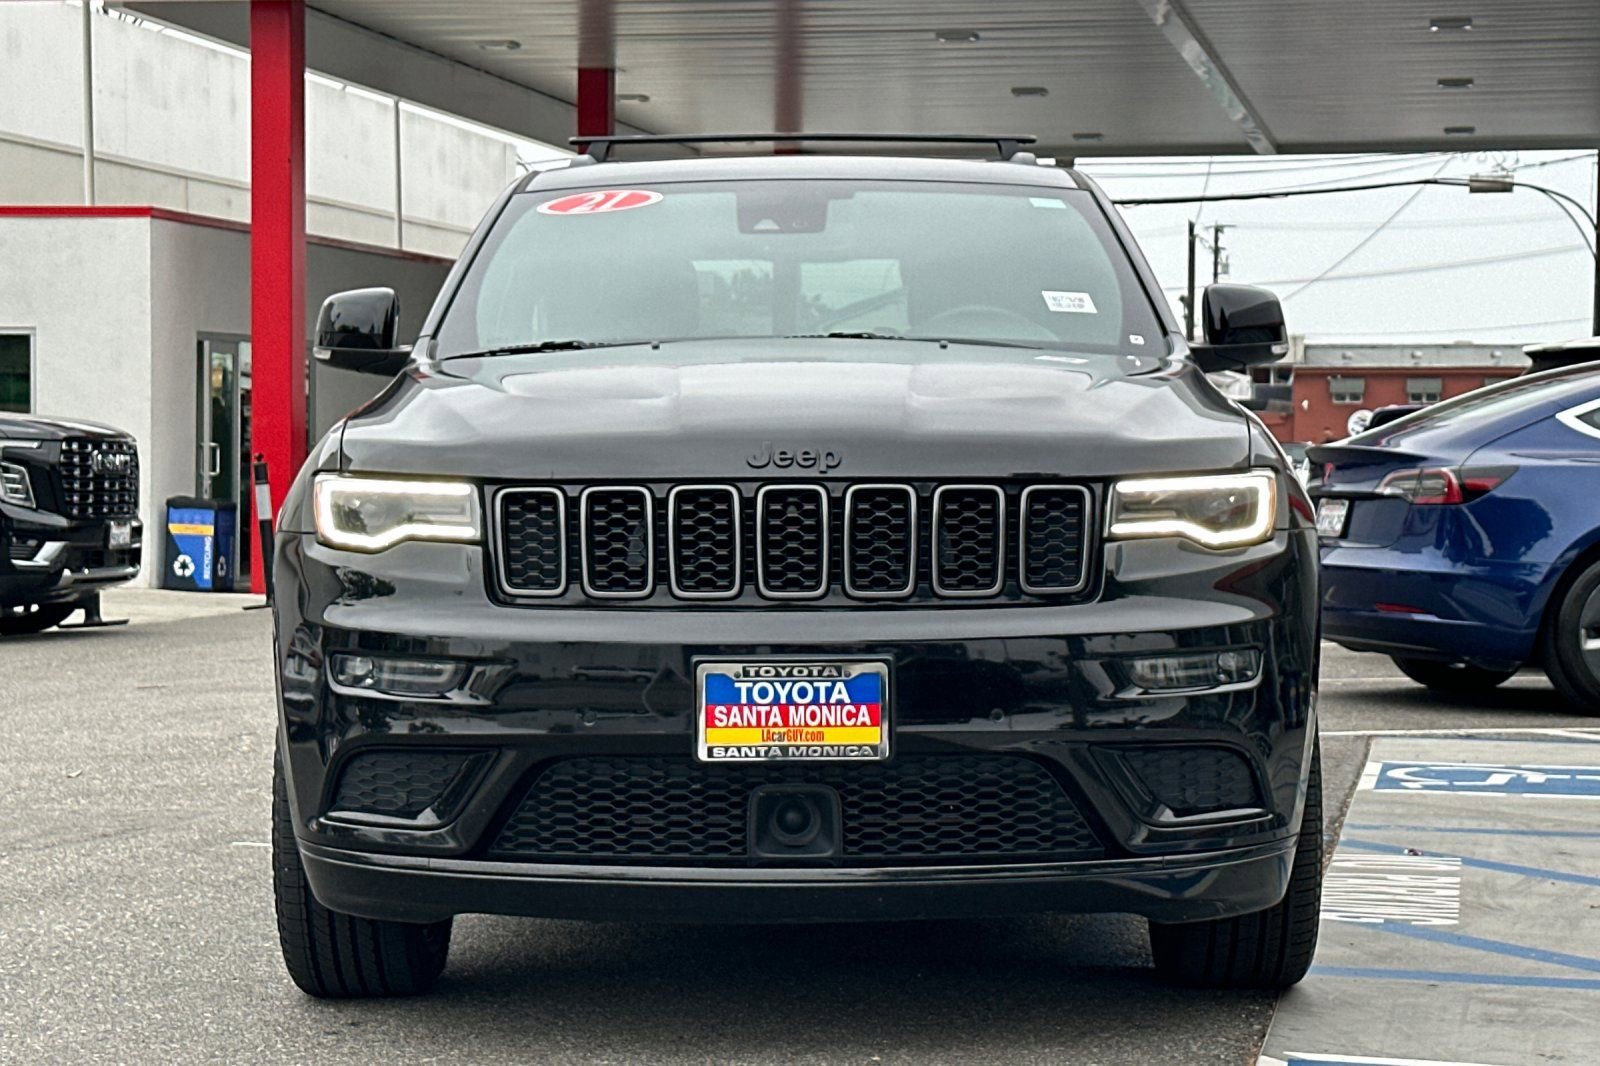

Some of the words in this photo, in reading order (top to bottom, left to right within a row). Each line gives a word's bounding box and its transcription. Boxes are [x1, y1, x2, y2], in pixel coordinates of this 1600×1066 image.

[566, 189, 631, 212] 21
[745, 440, 842, 475] Jeep
[744, 665, 839, 678] TOYOTA
[734, 681, 851, 704] TOYOTA
[714, 705, 784, 727] SANTA
[788, 704, 871, 727] MONICA
[712, 746, 784, 758] SANTA
[788, 745, 874, 757] MONICA
[1319, 872, 1462, 925] PARKING
